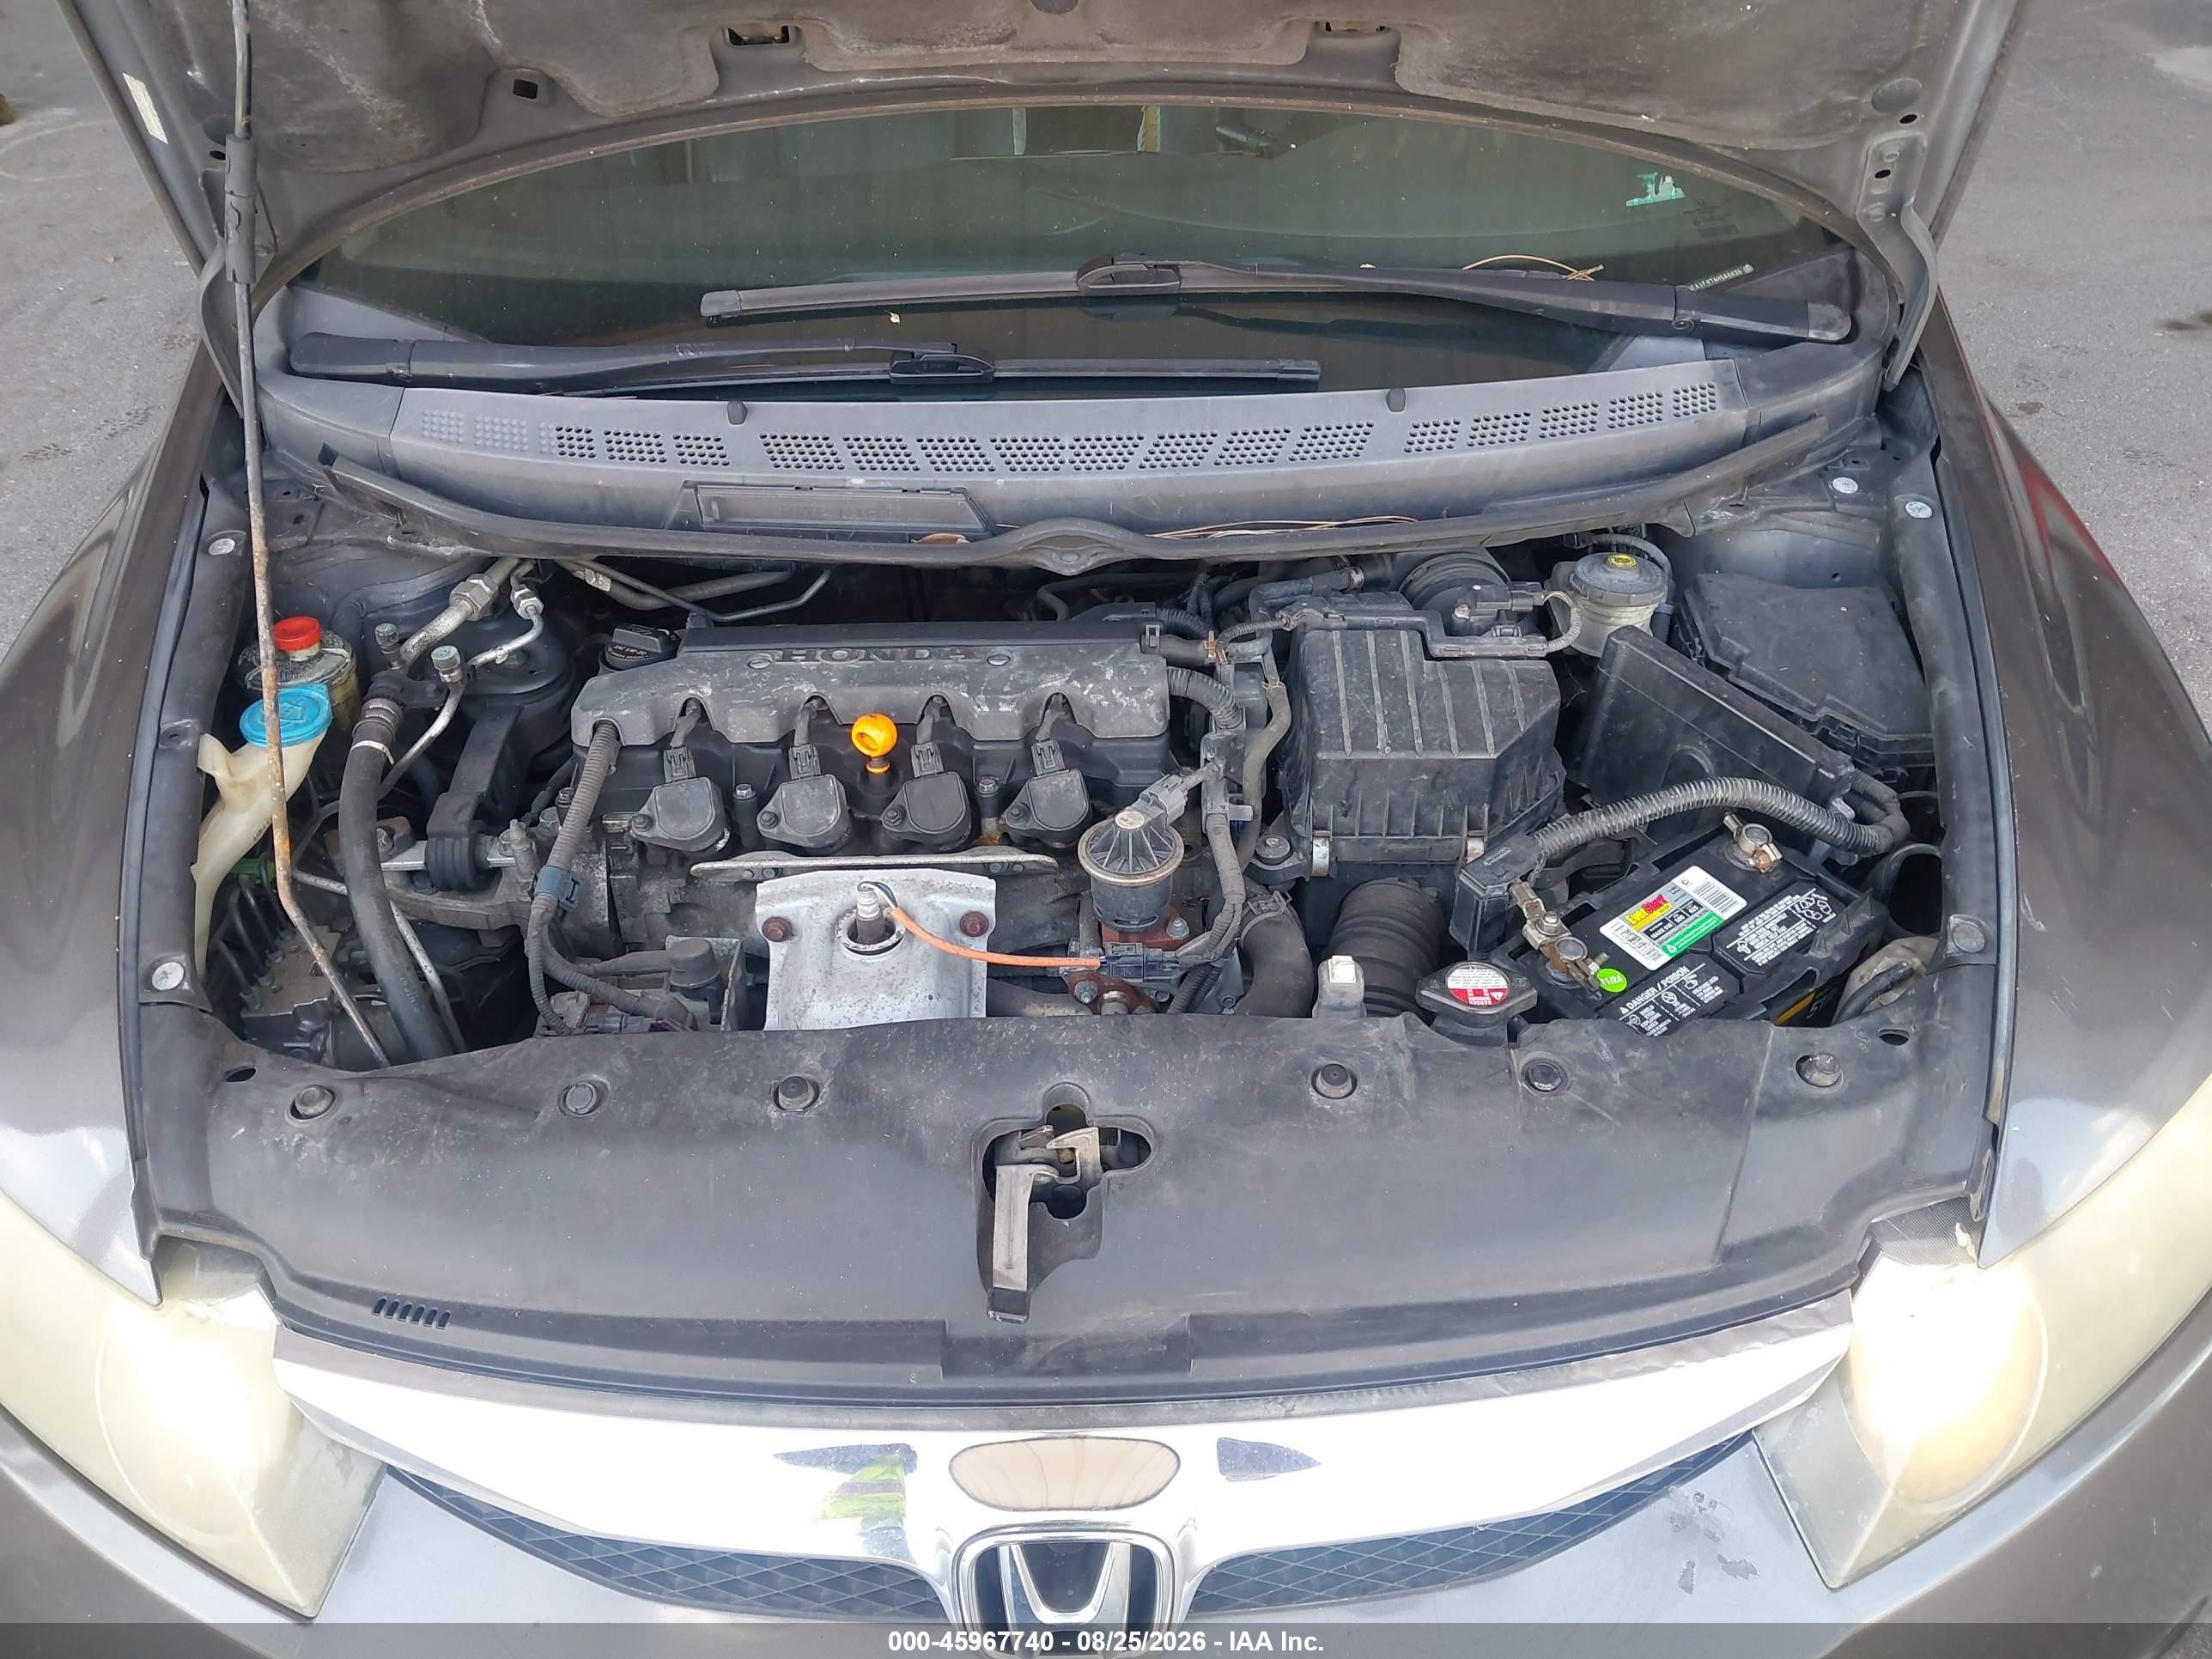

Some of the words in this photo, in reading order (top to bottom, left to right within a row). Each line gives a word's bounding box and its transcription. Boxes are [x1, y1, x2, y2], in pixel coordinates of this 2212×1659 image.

[775, 647, 983, 663] HONDA
[1624, 894, 1669, 925] EverStart
[1626, 987, 1659, 1011] DANGER
[1662, 965, 1690, 988] POISON
